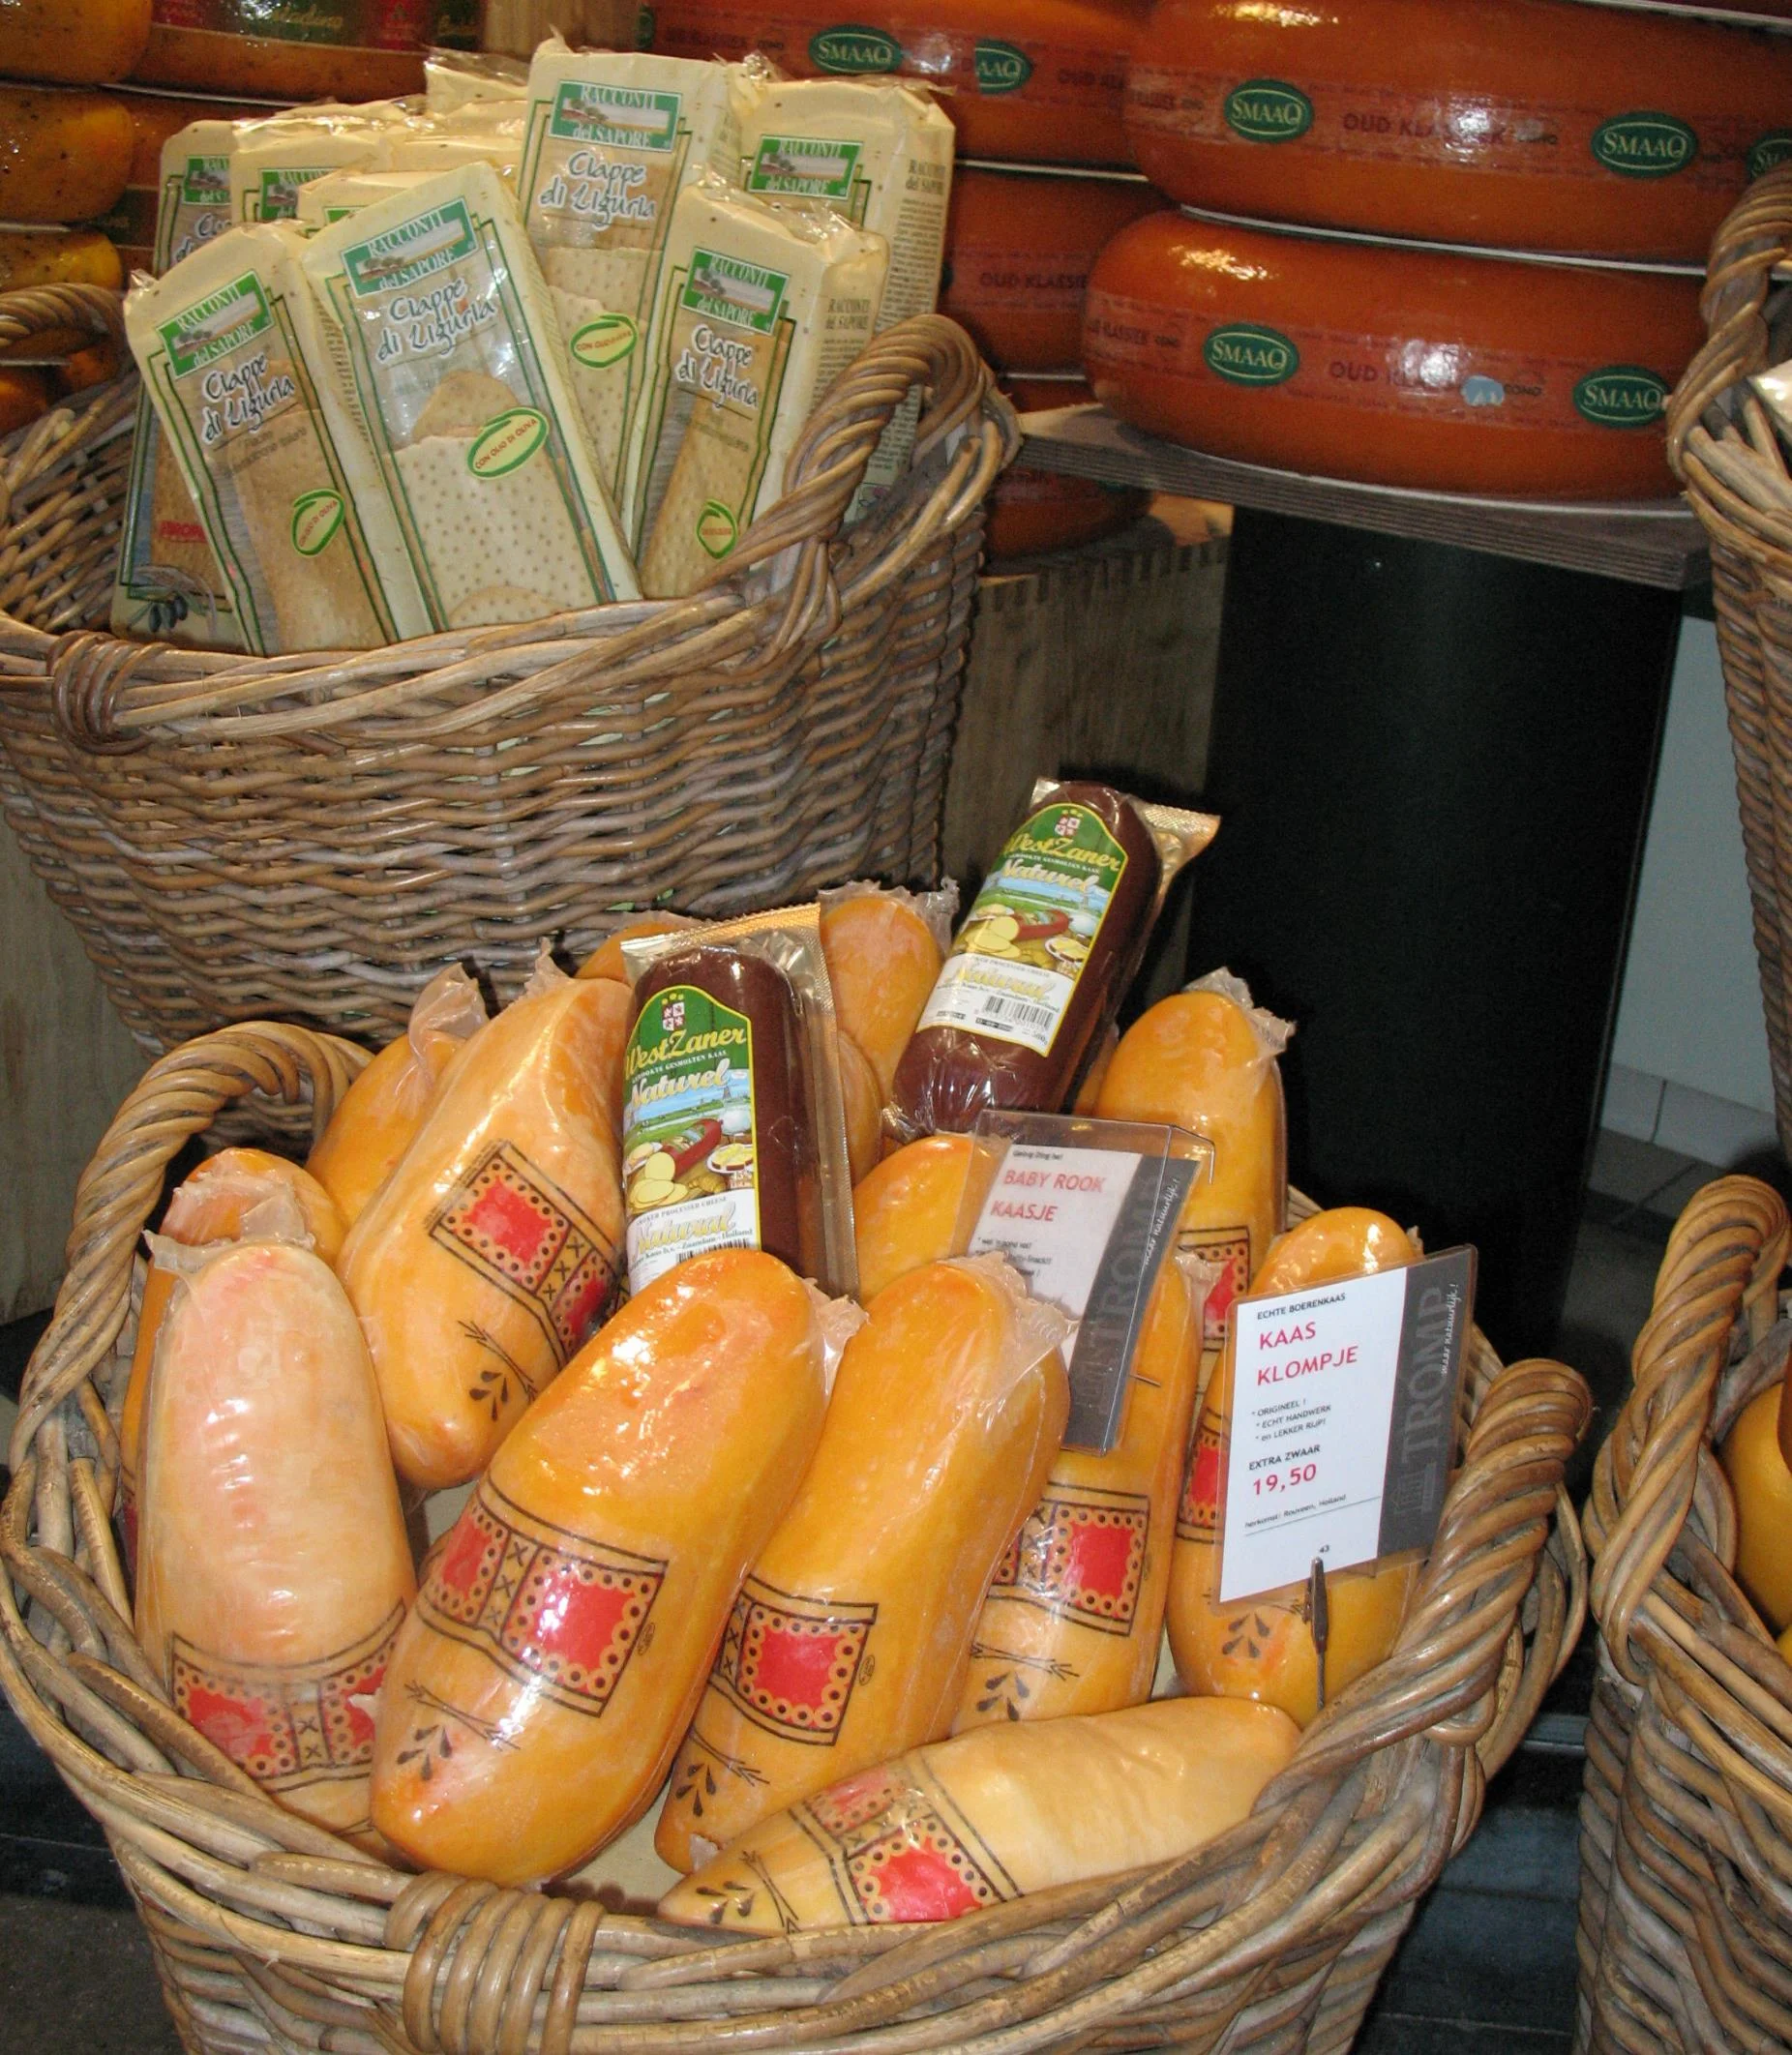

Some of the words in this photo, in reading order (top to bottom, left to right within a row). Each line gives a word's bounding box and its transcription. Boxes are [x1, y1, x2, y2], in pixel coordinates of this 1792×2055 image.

[819, 41, 892, 63] SMAAQ
[976, 58, 1022, 77] AAQ
[581, 86, 656, 109] RACCONTI
[1232, 99, 1302, 125] SMAAQ
[1342, 112, 1389, 134] OUD
[594, 128, 650, 147] SAPORE
[778, 139, 842, 157] RACCONTI
[1602, 132, 1687, 159] SMAAQ
[784, 178, 829, 194] SAPORE
[539, 176, 567, 207] di
[572, 183, 656, 230] Liguria
[368, 209, 445, 257] RACCONTI
[398, 249, 456, 285] SAPORE
[709, 255, 769, 288] RACCONTI
[176, 283, 242, 331] RACCONTI
[712, 299, 757, 327] SAPORE
[208, 320, 254, 360] SAPORE
[376, 328, 401, 361] di
[409, 300, 496, 357] Liguria
[675, 349, 697, 382] di
[1211, 340, 1287, 370] SMAAQ
[1329, 361, 1378, 383] OUD
[203, 406, 223, 443] di
[225, 375, 295, 432] Liguria
[1584, 385, 1662, 411] SMAAQ
[1001, 858, 1100, 892] Naturel
[631, 1057, 731, 1108] Naturel
[1003, 1169, 1051, 1188] BABY
[1053, 1173, 1106, 1193] ROOK
[990, 1200, 1059, 1222] KAASJE
[1257, 1306, 1286, 1320] ECHTE
[1289, 1293, 1346, 1314] BOERENKAAS
[1260, 1321, 1317, 1350] KAAS
[1257, 1346, 1359, 1385] KLOMPJE
[1402, 1287, 1448, 1463] TROMP
[1257, 1399, 1300, 1416] ORIGINEEL
[1261, 1415, 1284, 1429] ECHT
[1285, 1404, 1331, 1421] HANDWERK
[1261, 1433, 1272, 1442] en
[1273, 1424, 1303, 1439] LEKKER
[1248, 1455, 1282, 1471] EXTRA
[1284, 1444, 1321, 1462] ZWAAR
[1252, 1463, 1317, 1496] 19,50
